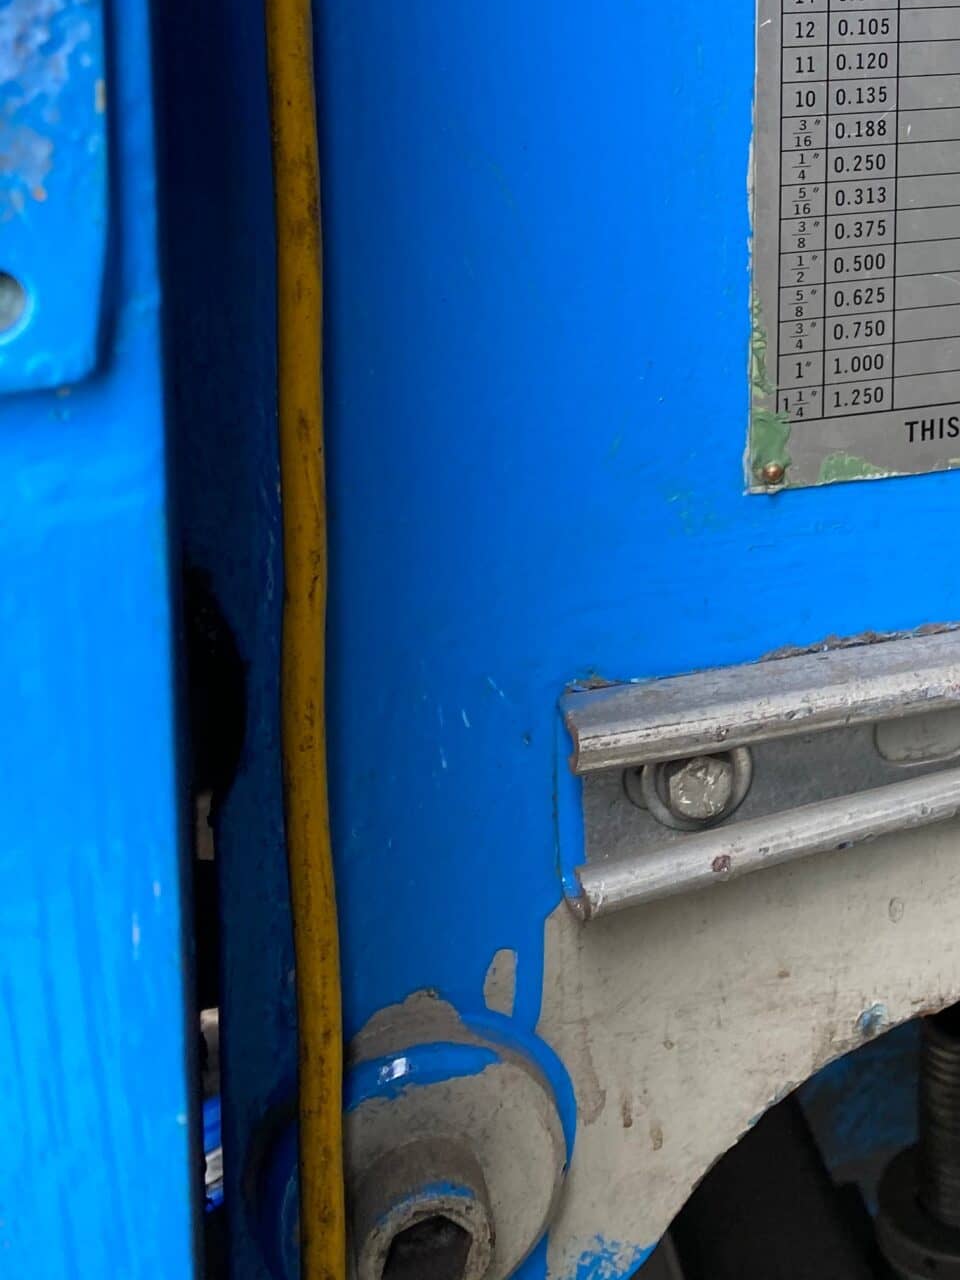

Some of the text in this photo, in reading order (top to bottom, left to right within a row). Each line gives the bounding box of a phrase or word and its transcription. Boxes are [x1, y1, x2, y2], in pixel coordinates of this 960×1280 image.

[795, 18, 889, 39] 12 0.105
[795, 56, 815, 73] 11
[836, 52, 888, 71] 0.120
[796, 86, 887, 108] 10 0.135
[835, 119, 887, 139] 0.188
[834, 153, 886, 173] 0.250
[835, 186, 886, 206] 0.313
[835, 219, 886, 240] 0.375
[834, 253, 885, 274] 0.500
[834, 287, 885, 307] 0.625
[833, 319, 885, 340] 0.750
[834, 353, 884, 375] 1.000
[834, 386, 884, 408] 1.250
[904, 416, 960, 443] THIS
